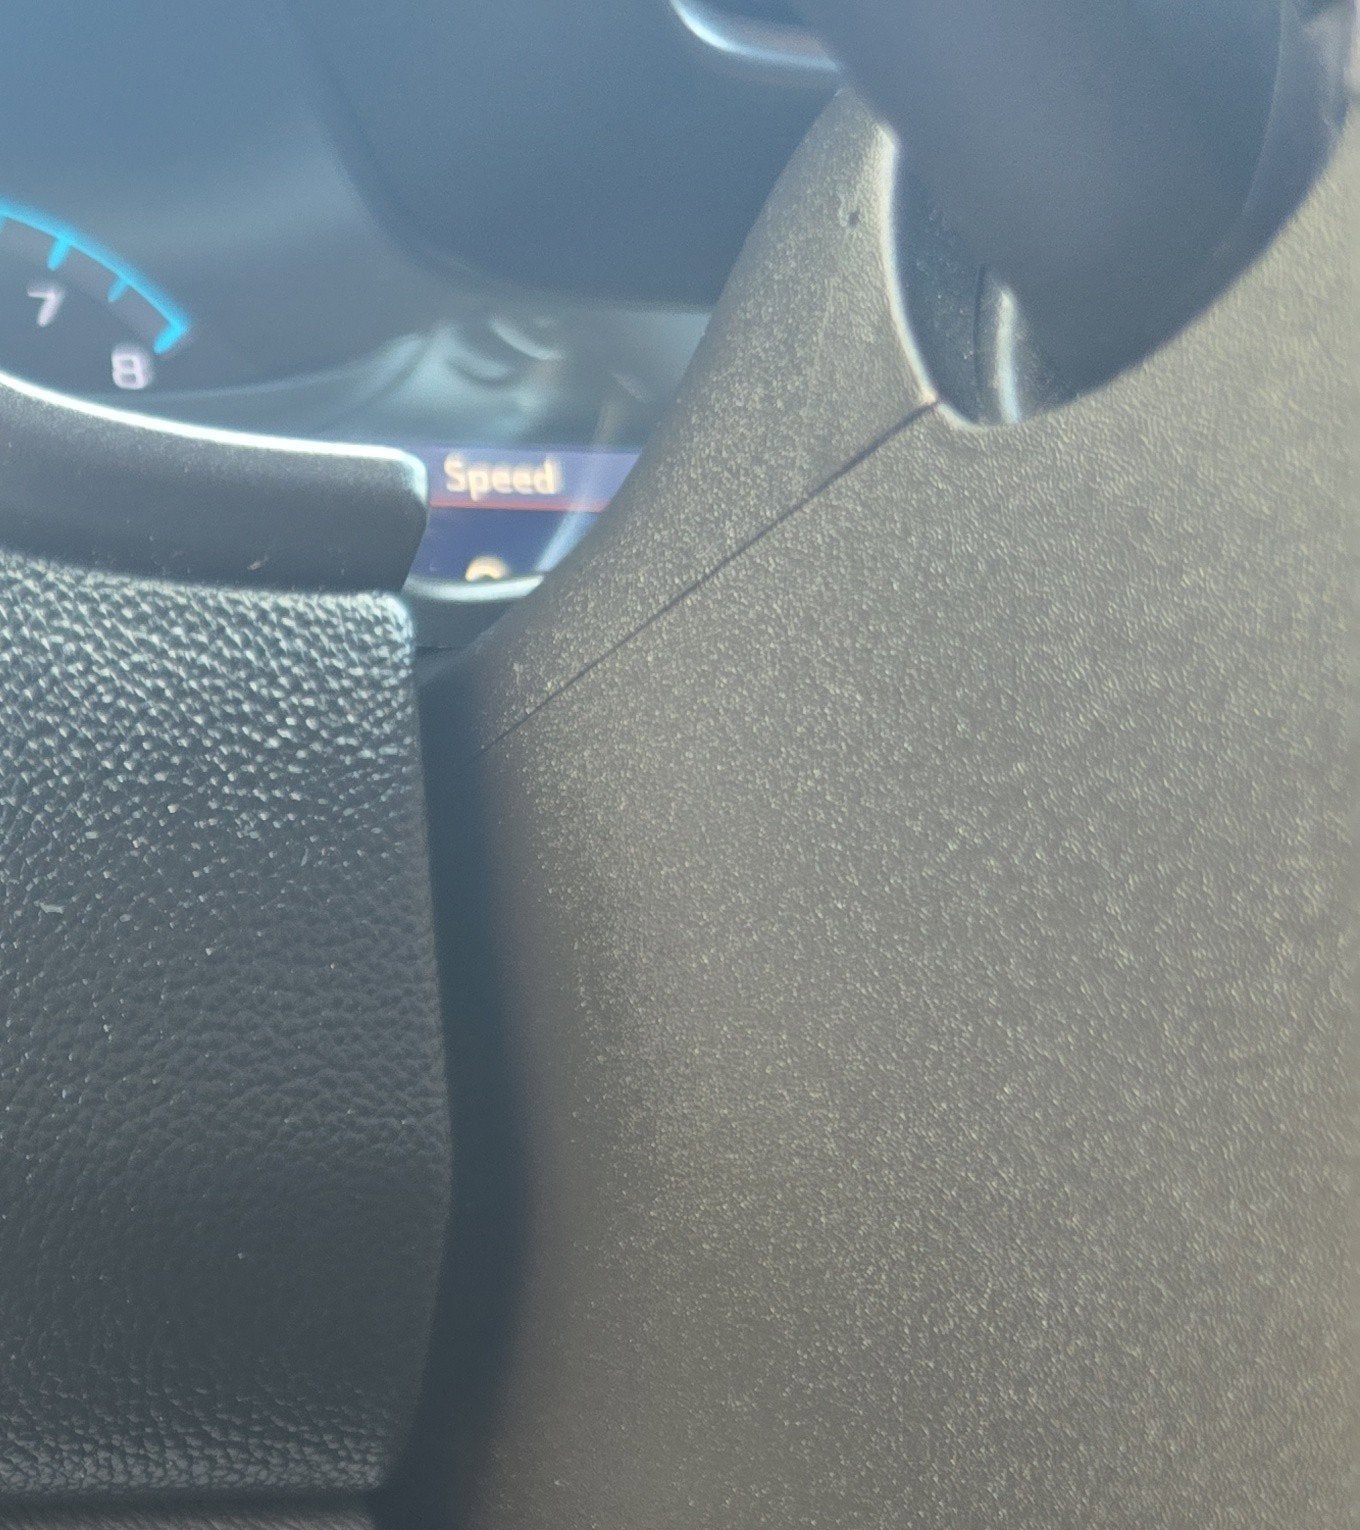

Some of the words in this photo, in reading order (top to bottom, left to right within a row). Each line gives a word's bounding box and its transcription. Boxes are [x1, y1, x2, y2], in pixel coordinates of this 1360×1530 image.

[27, 285, 65, 327] 7
[110, 345, 153, 391] 8
[443, 452, 562, 502] Speed
